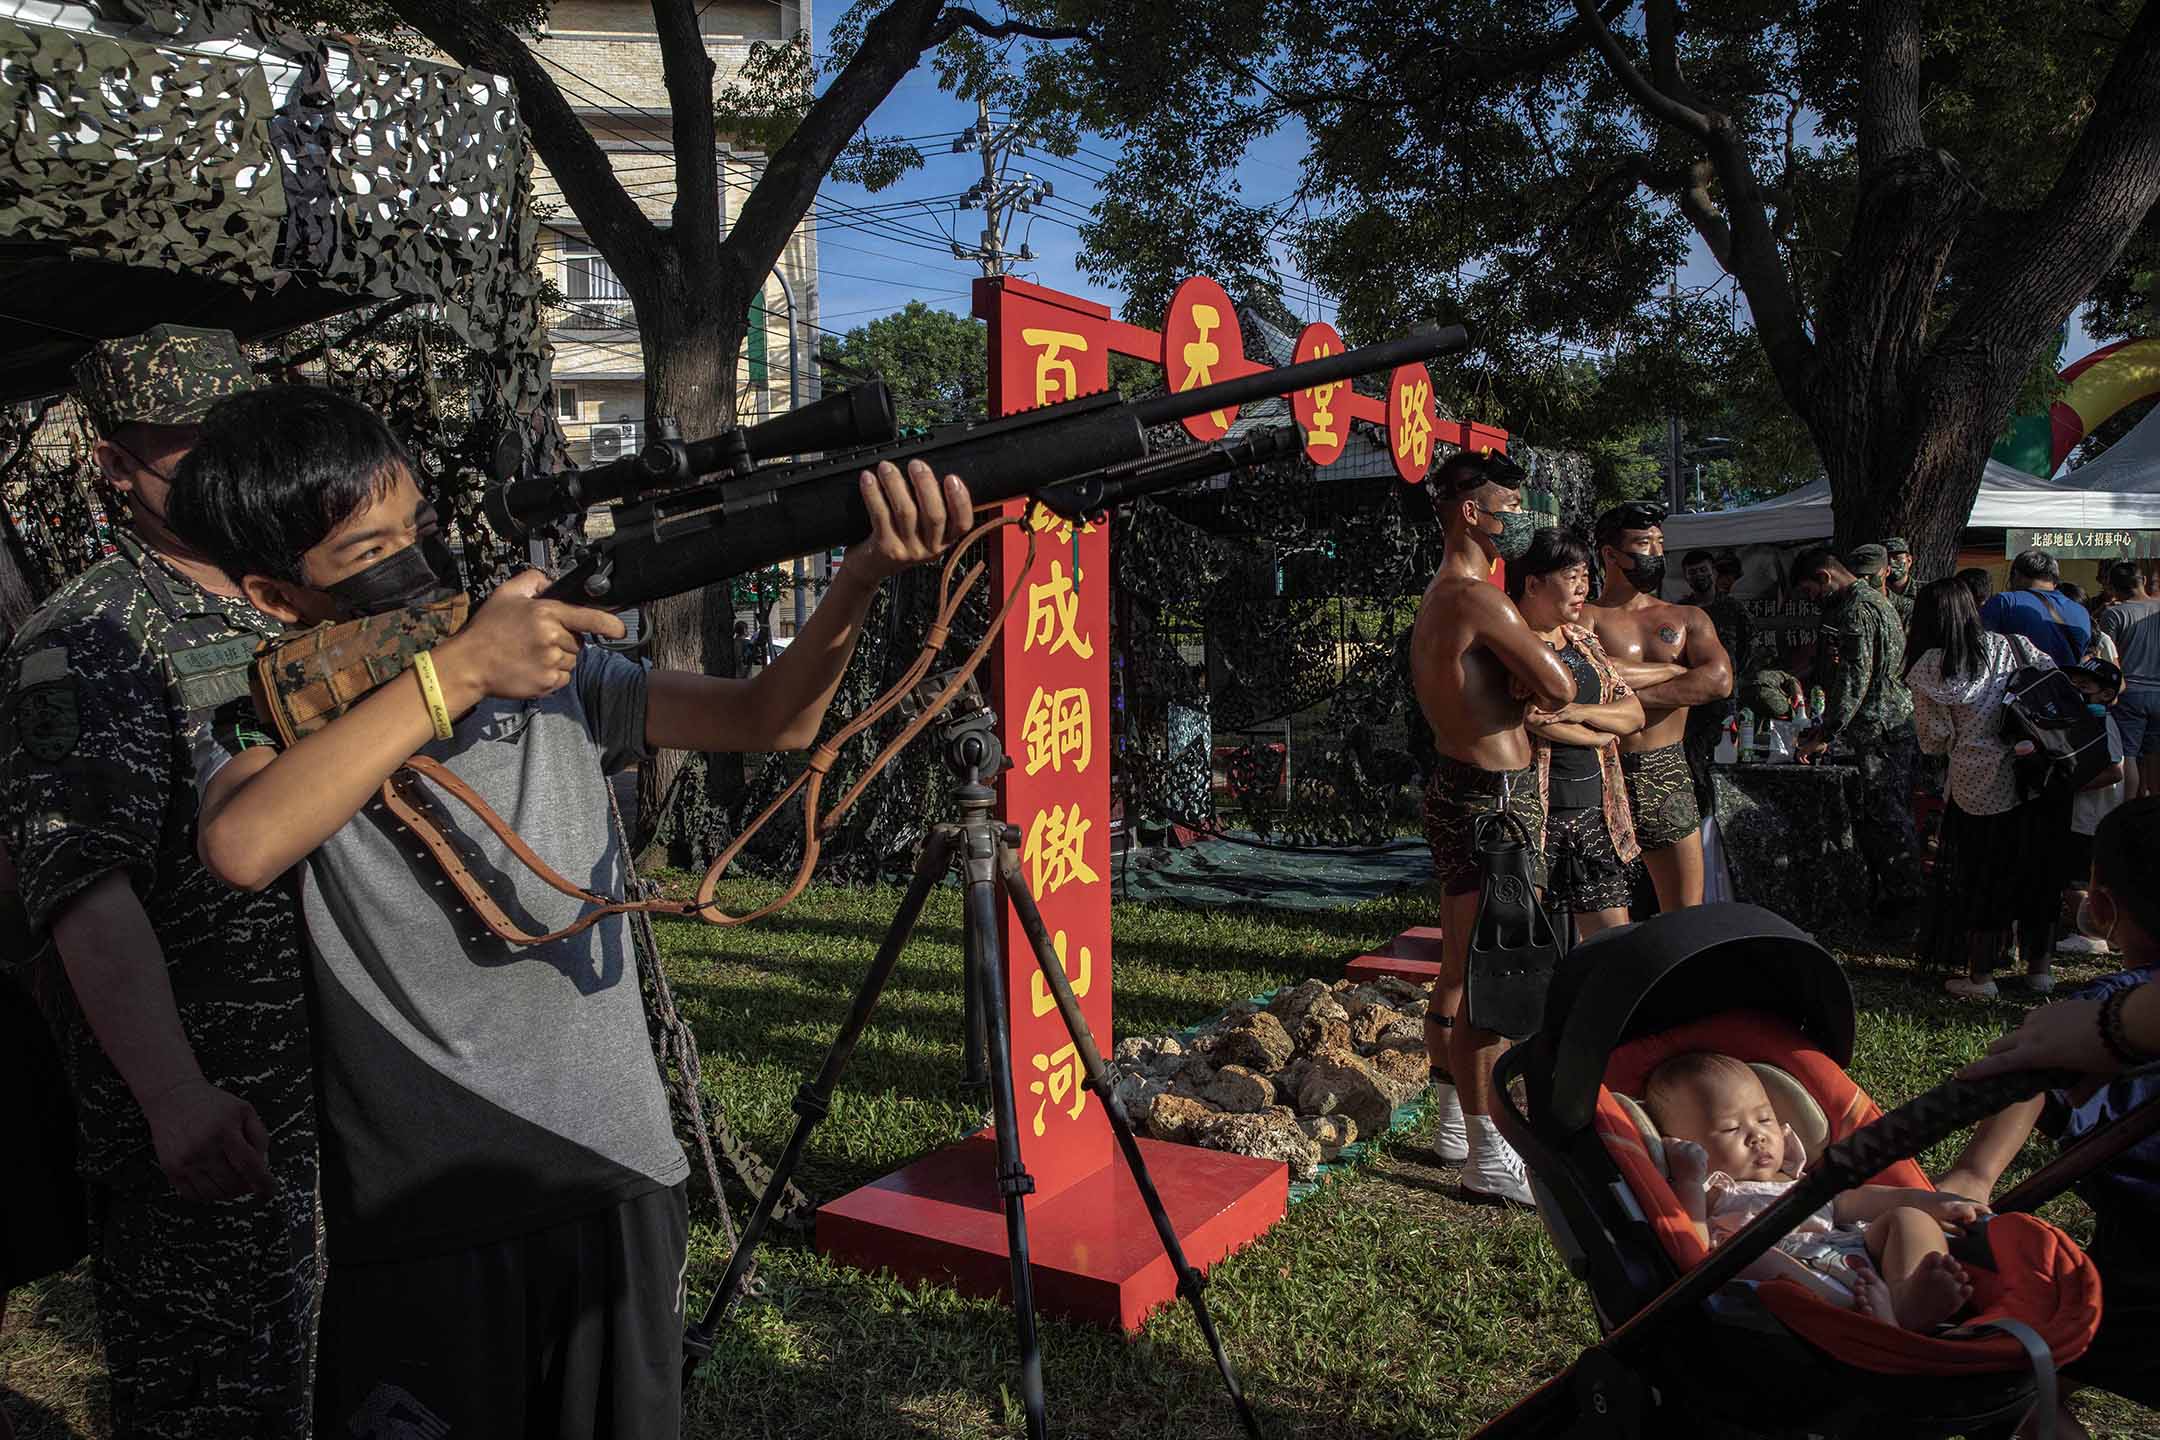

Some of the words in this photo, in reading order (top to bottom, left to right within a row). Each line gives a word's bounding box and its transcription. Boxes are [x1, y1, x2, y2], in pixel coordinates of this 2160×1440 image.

[2031, 532, 2132, 547] 北部地區人才招募中心
